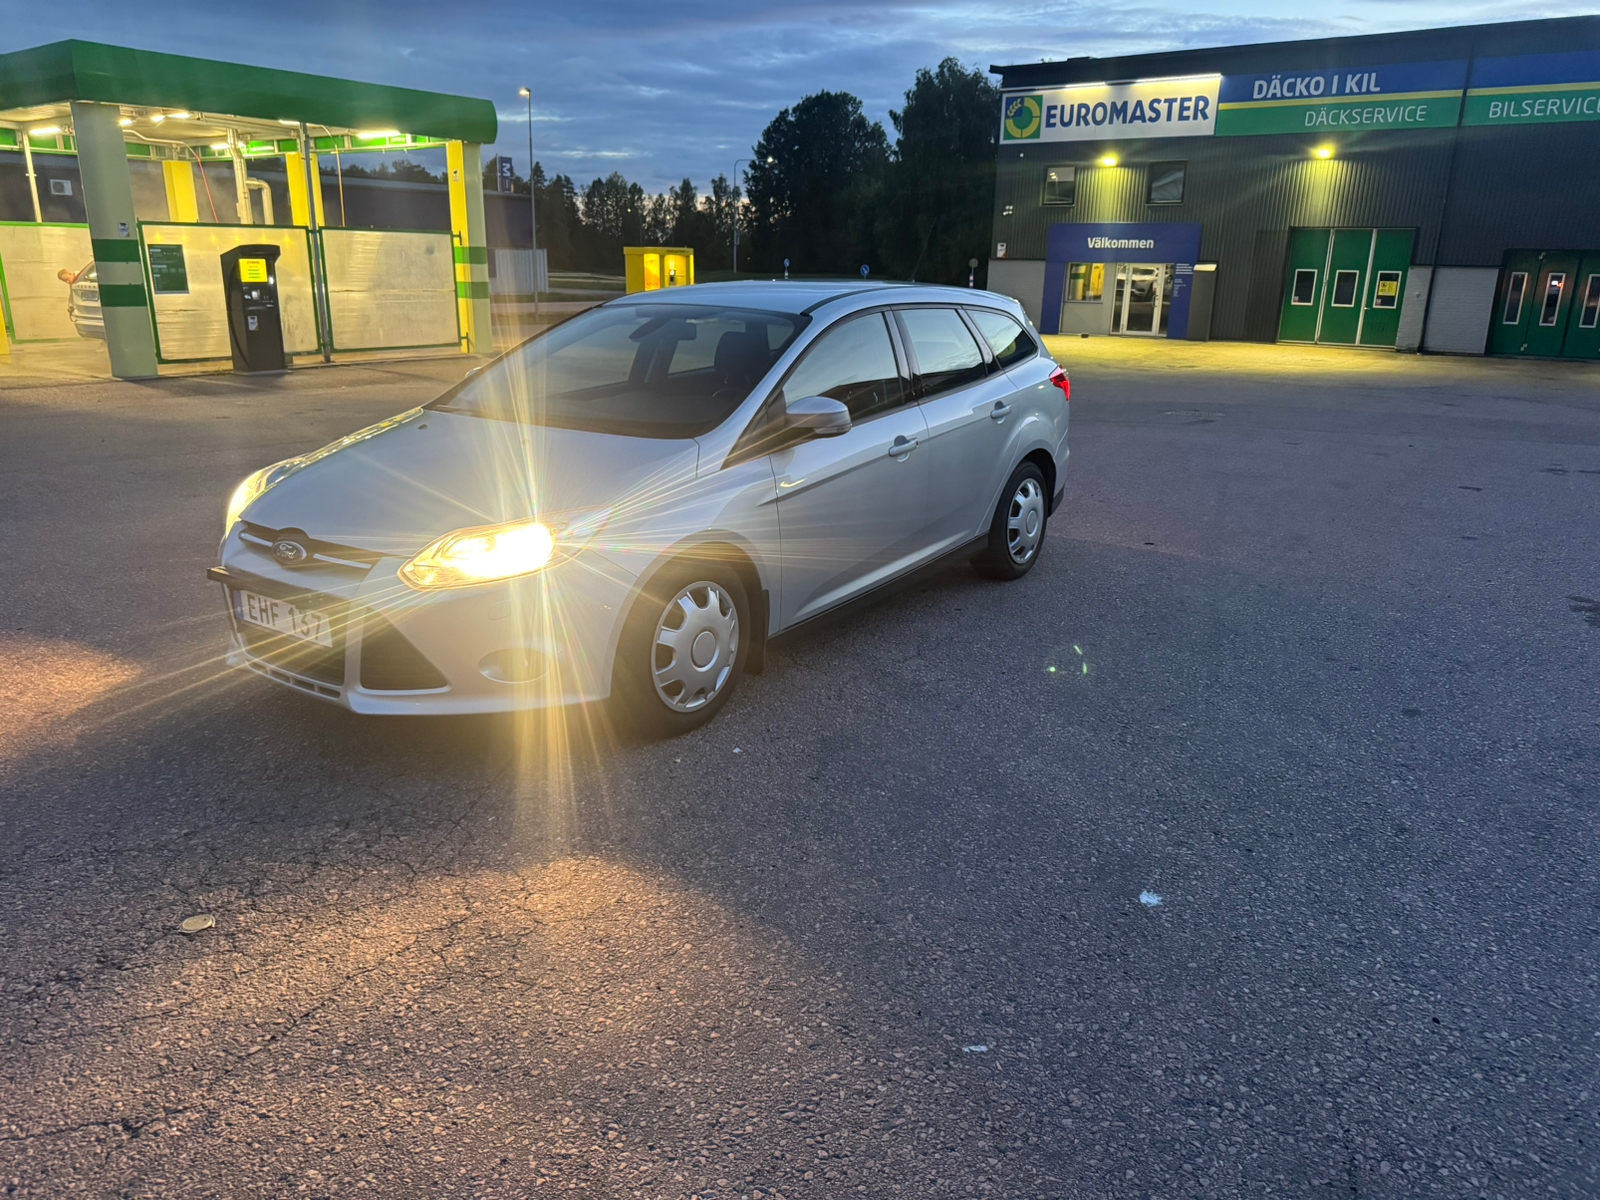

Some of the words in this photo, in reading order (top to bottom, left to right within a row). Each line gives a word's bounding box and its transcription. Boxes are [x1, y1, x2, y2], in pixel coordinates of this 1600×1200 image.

[1252, 74, 1325, 99] DÄCKO
[1331, 75, 1339, 94] I
[1345, 72, 1381, 94] KIL
[1045, 95, 1210, 128] EUROMASTER
[1304, 105, 1427, 127] DÄCKSERVICE
[1087, 237, 1154, 249] Välkommen
[246, 593, 279, 627] EHF
